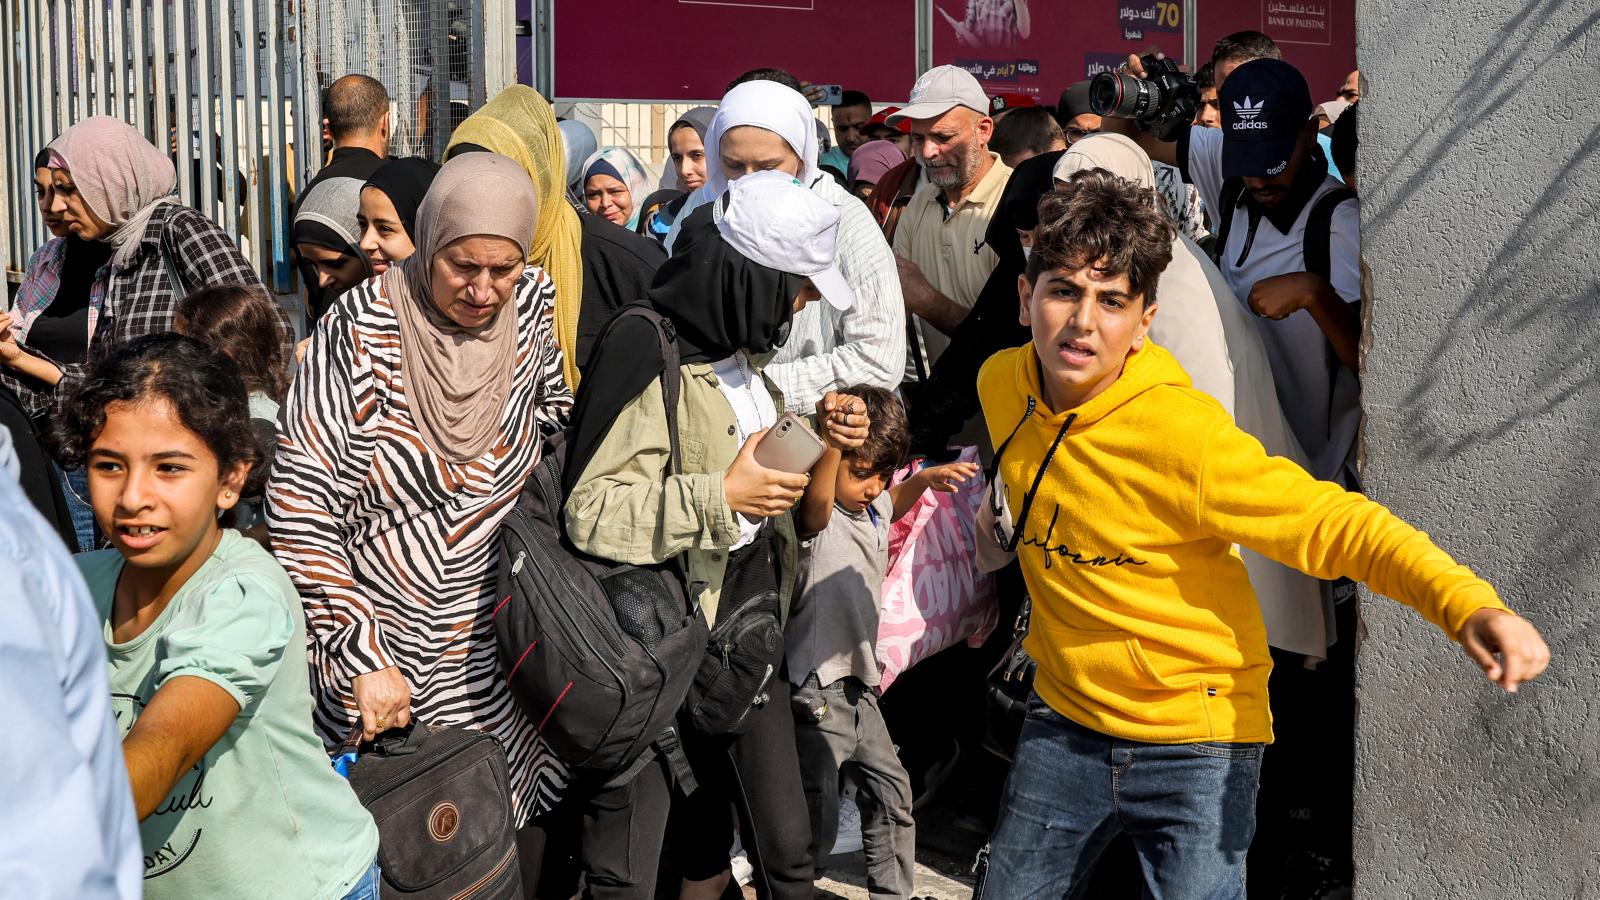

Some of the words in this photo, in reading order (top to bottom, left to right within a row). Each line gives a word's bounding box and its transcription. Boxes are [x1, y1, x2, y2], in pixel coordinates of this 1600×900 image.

[1120, 7, 1140, 20] دولار
[1141, 5, 1155, 20] ألف
[1268, 1, 1305, 13] فلسطين
[1306, 5, 1325, 17] بنك
[1156, 2, 1180, 28] 70
[1268, 16, 1285, 26] BANK
[1285, 18, 1295, 27] OF
[1295, 19, 1325, 30] PALESTINE
[984, 65, 996, 79] في
[996, 64, 1009, 77] أيام
[1010, 64, 1016, 75] 7
[1232, 119, 1268, 131] adidas
[1266, 160, 1287, 176] adidas
